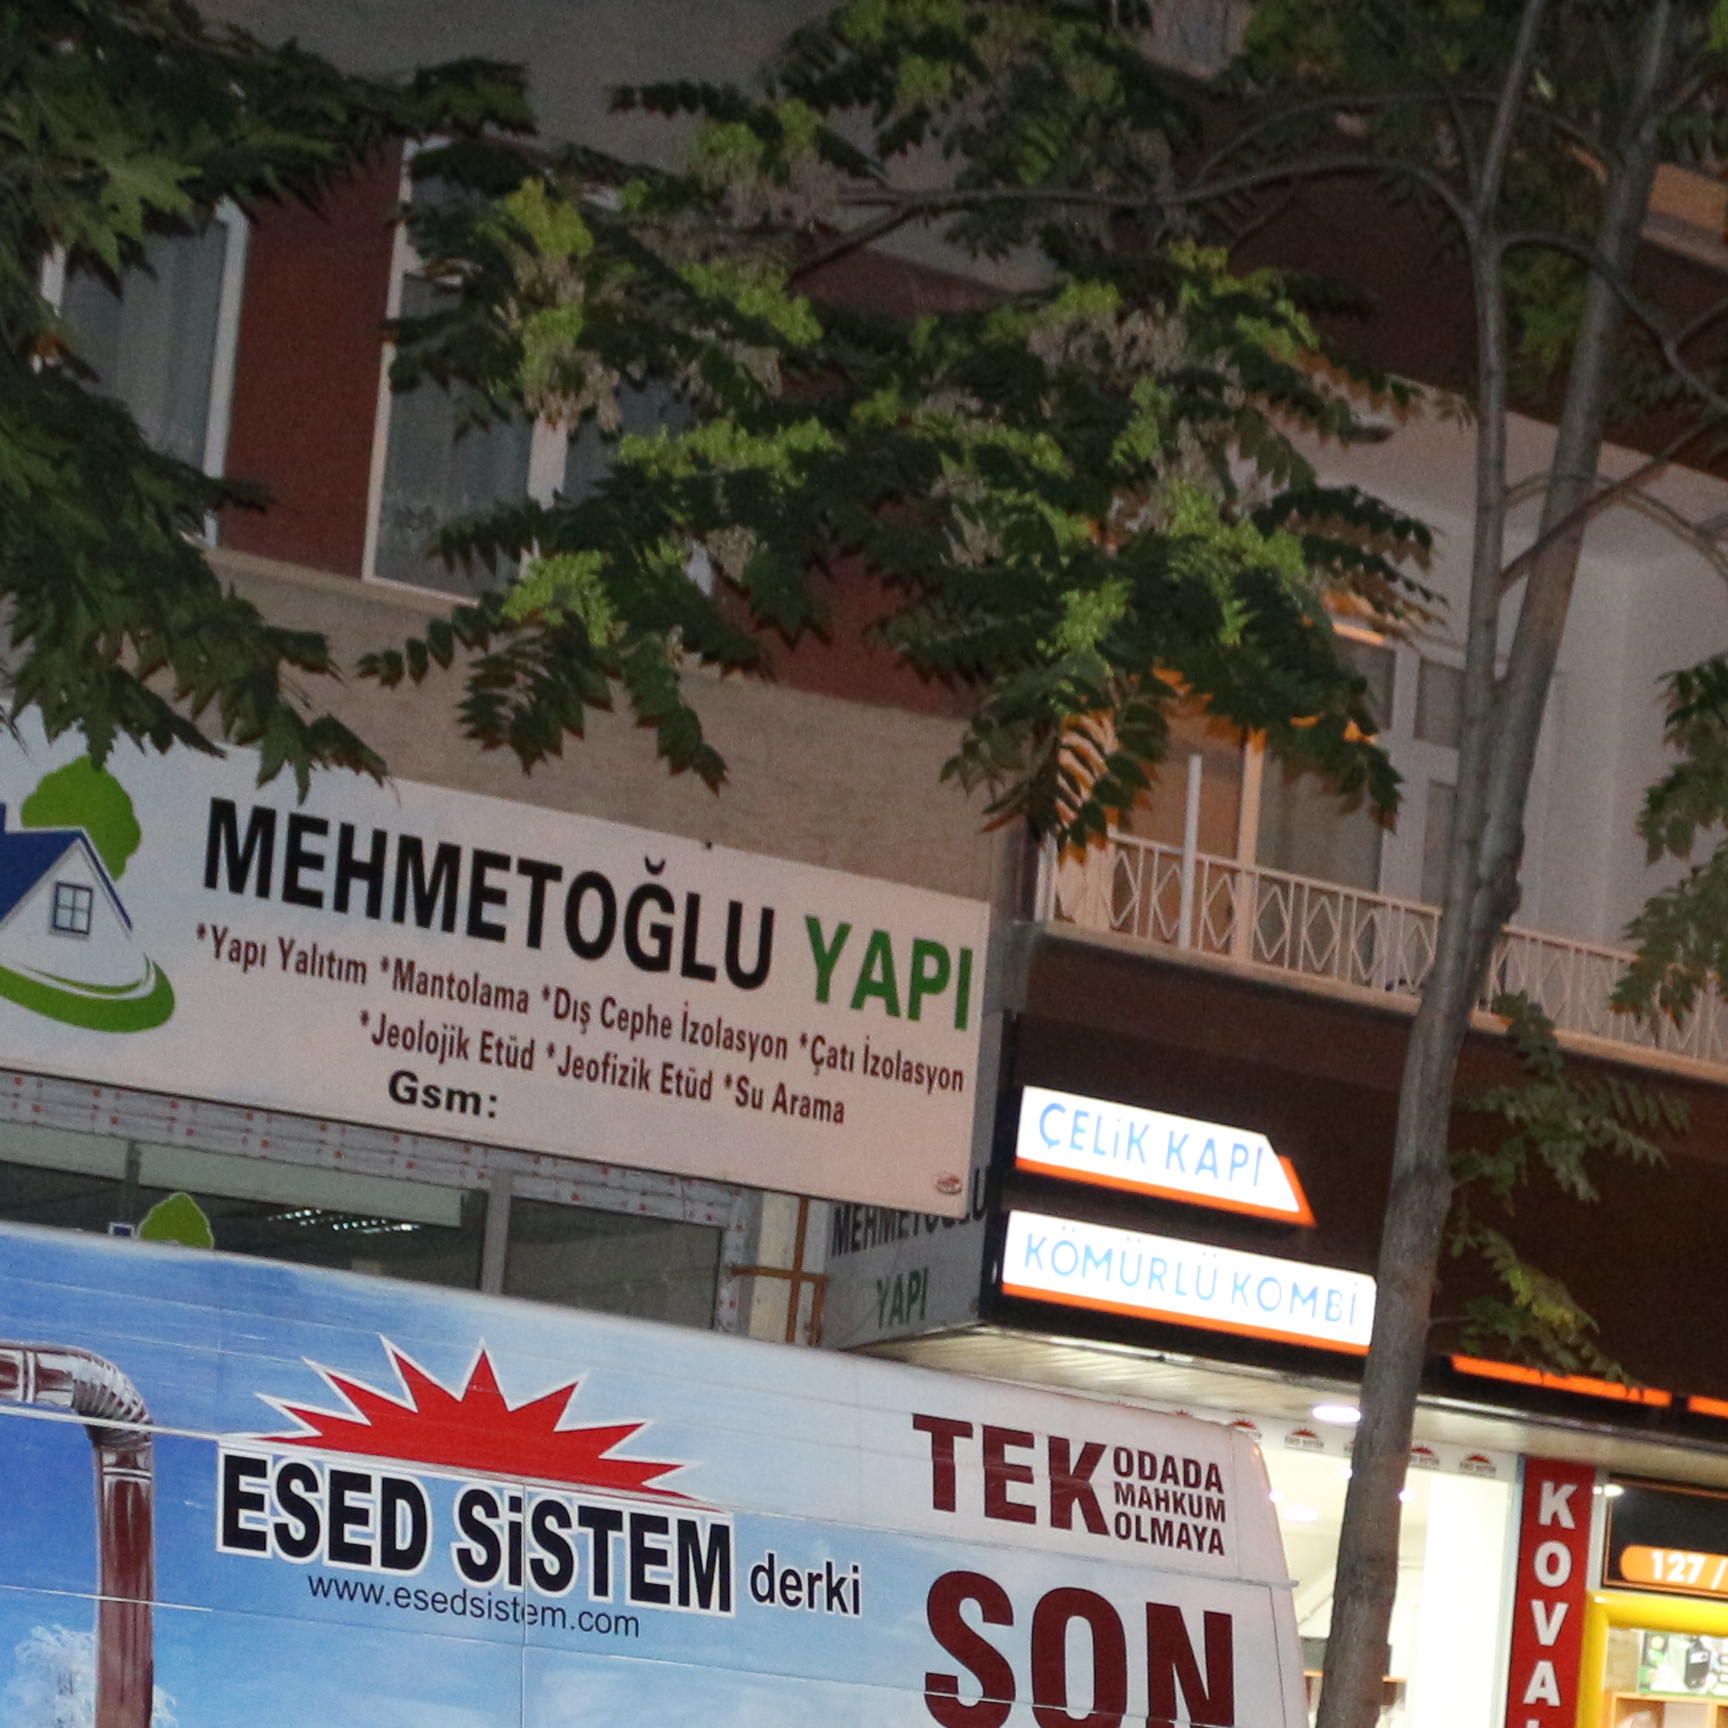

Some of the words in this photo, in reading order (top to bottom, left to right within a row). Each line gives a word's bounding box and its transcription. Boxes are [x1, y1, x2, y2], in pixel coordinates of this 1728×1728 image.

[203, 796, 776, 990] MEHMETOĞLU
[804, 915, 974, 1032] YAPI
[278, 936, 368, 986] Yalıtım
[600, 995, 673, 1044] Cephe
[680, 1001, 789, 1064] İzolasyon
[862, 1034, 964, 1096] İzolasyon
[387, 1068, 499, 1120] Gsm:
[478, 1028, 535, 1073] Etüd
[659, 1055, 713, 1104] Etüd
[771, 1081, 846, 1127] Arama
[1165, 1130, 1264, 1188] KAPI
[876, 1266, 930, 1329] YAPI
[1024, 1225, 1218, 1301] KÖMÜRLÜ
[1231, 1266, 1359, 1327] KOMBİ
[912, 1413, 1111, 1537] TEK
[1112, 1446, 1225, 1495] ODADA
[1112, 1480, 1227, 1524] MAHKUM
[218, 1453, 430, 1574] ESED
[748, 1551, 864, 1617] derki
[1113, 1511, 1225, 1556] OLMAYA
[306, 1573, 641, 1639] www.esedsistem.com
